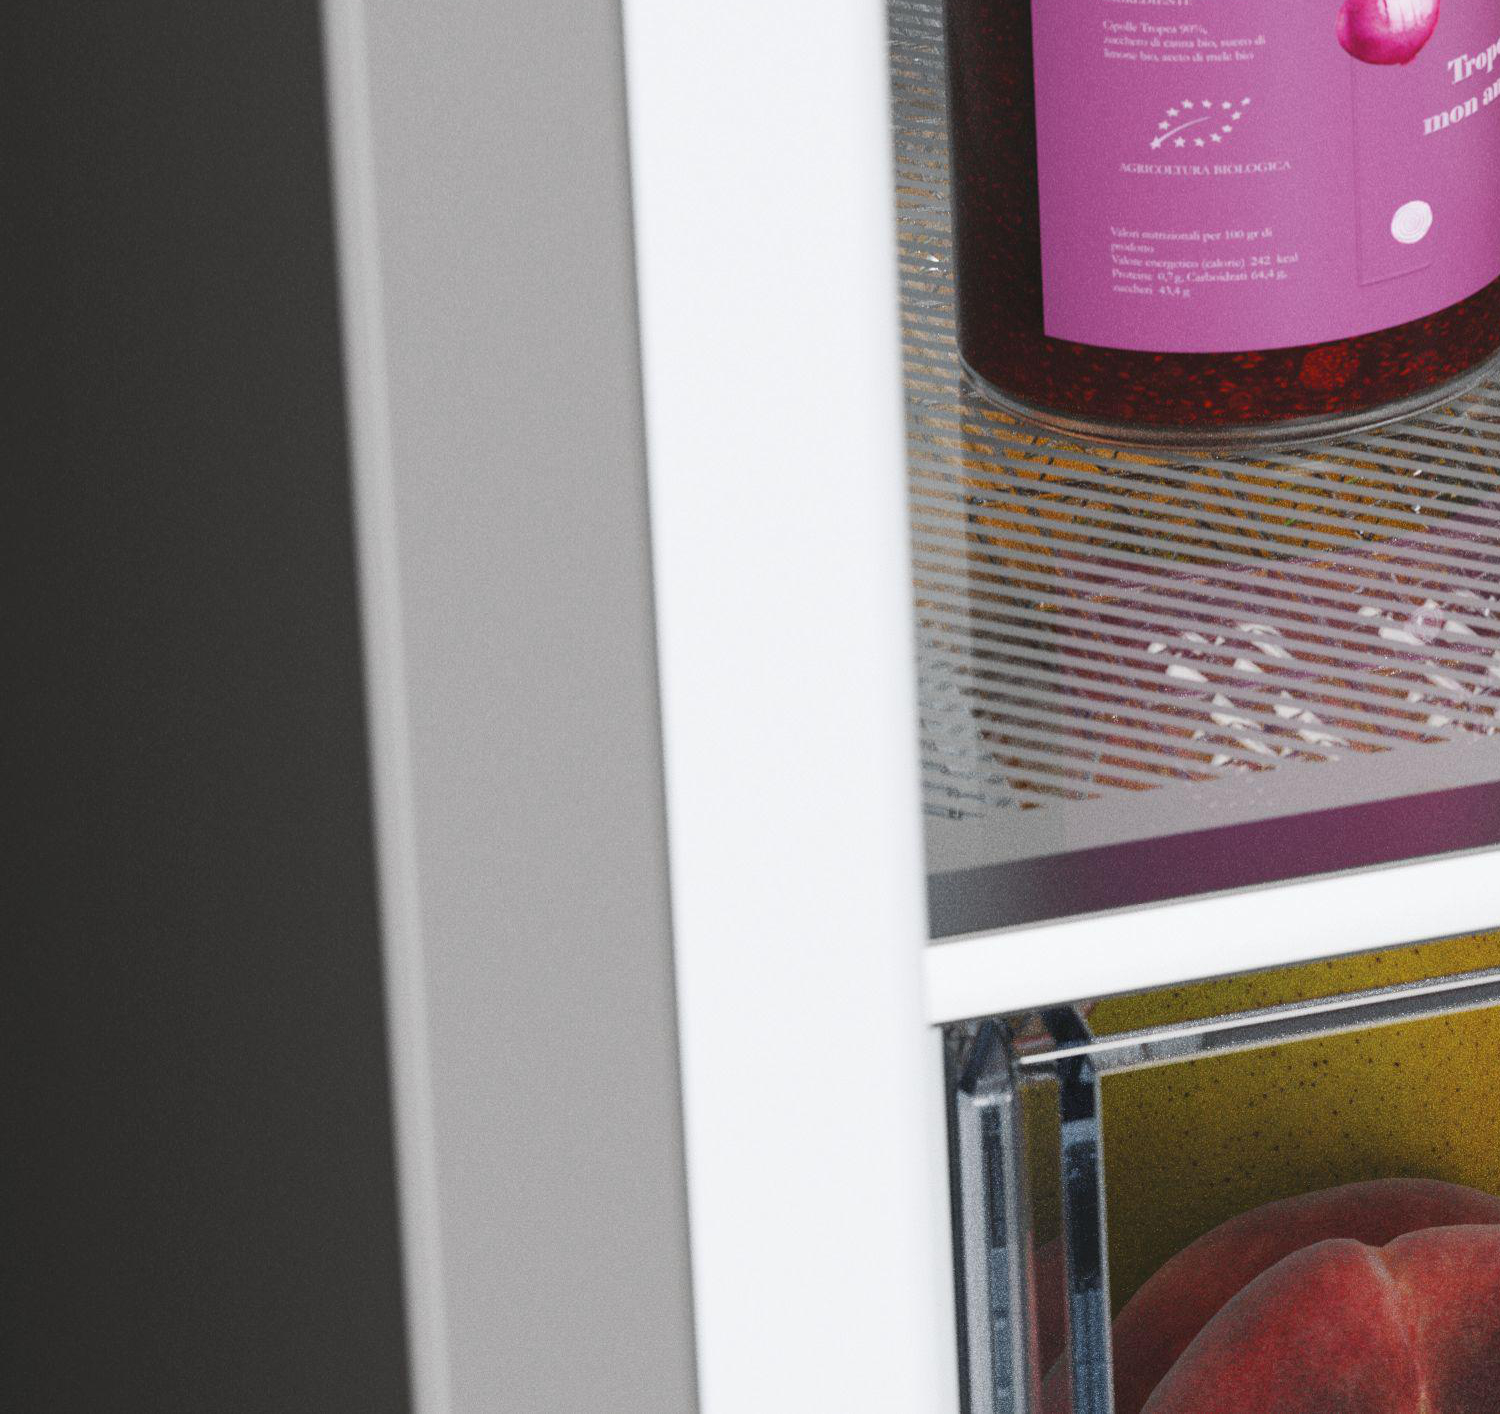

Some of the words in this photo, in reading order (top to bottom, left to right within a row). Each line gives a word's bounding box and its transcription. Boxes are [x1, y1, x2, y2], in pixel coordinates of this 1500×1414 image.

[1140, 22, 1177, 35] Tropea
[1150, 37, 1161, 47] di
[1254, 34, 1266, 46] di
[1192, 52, 1204, 62] di
[1423, 96, 1478, 135] mon
[1120, 162, 1210, 176] AGRICOLTURA
[1214, 160, 1292, 175] BIOLOGICA
[1202, 231, 1221, 243] per
[1225, 230, 1243, 240] 100
[1261, 227, 1273, 238] di
[1251, 255, 1270, 266] 242
[1277, 252, 1299, 265] kcal
